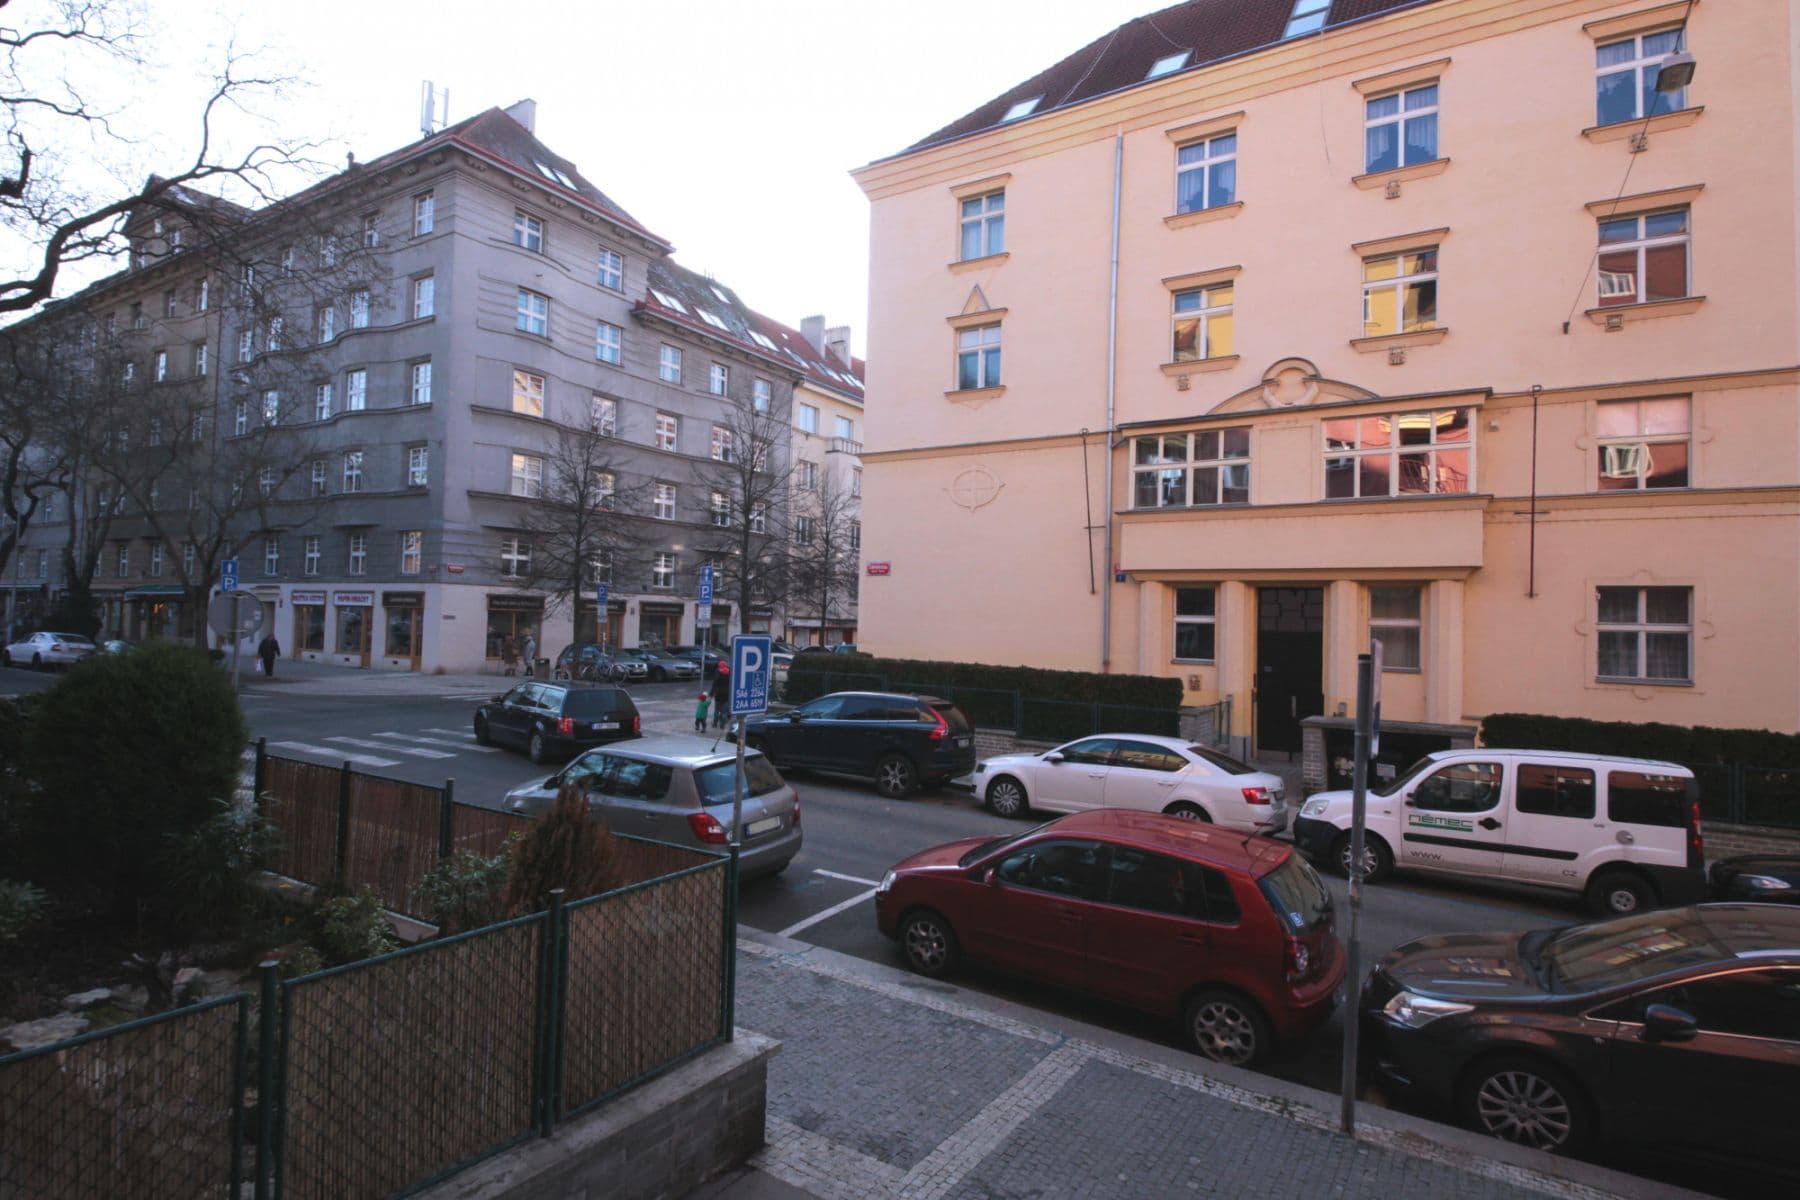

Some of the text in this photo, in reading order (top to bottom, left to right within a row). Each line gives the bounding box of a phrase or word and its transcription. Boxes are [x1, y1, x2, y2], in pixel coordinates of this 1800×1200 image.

[224, 577, 234, 590] P
[701, 585, 710, 598] P
[739, 645, 763, 689] P
